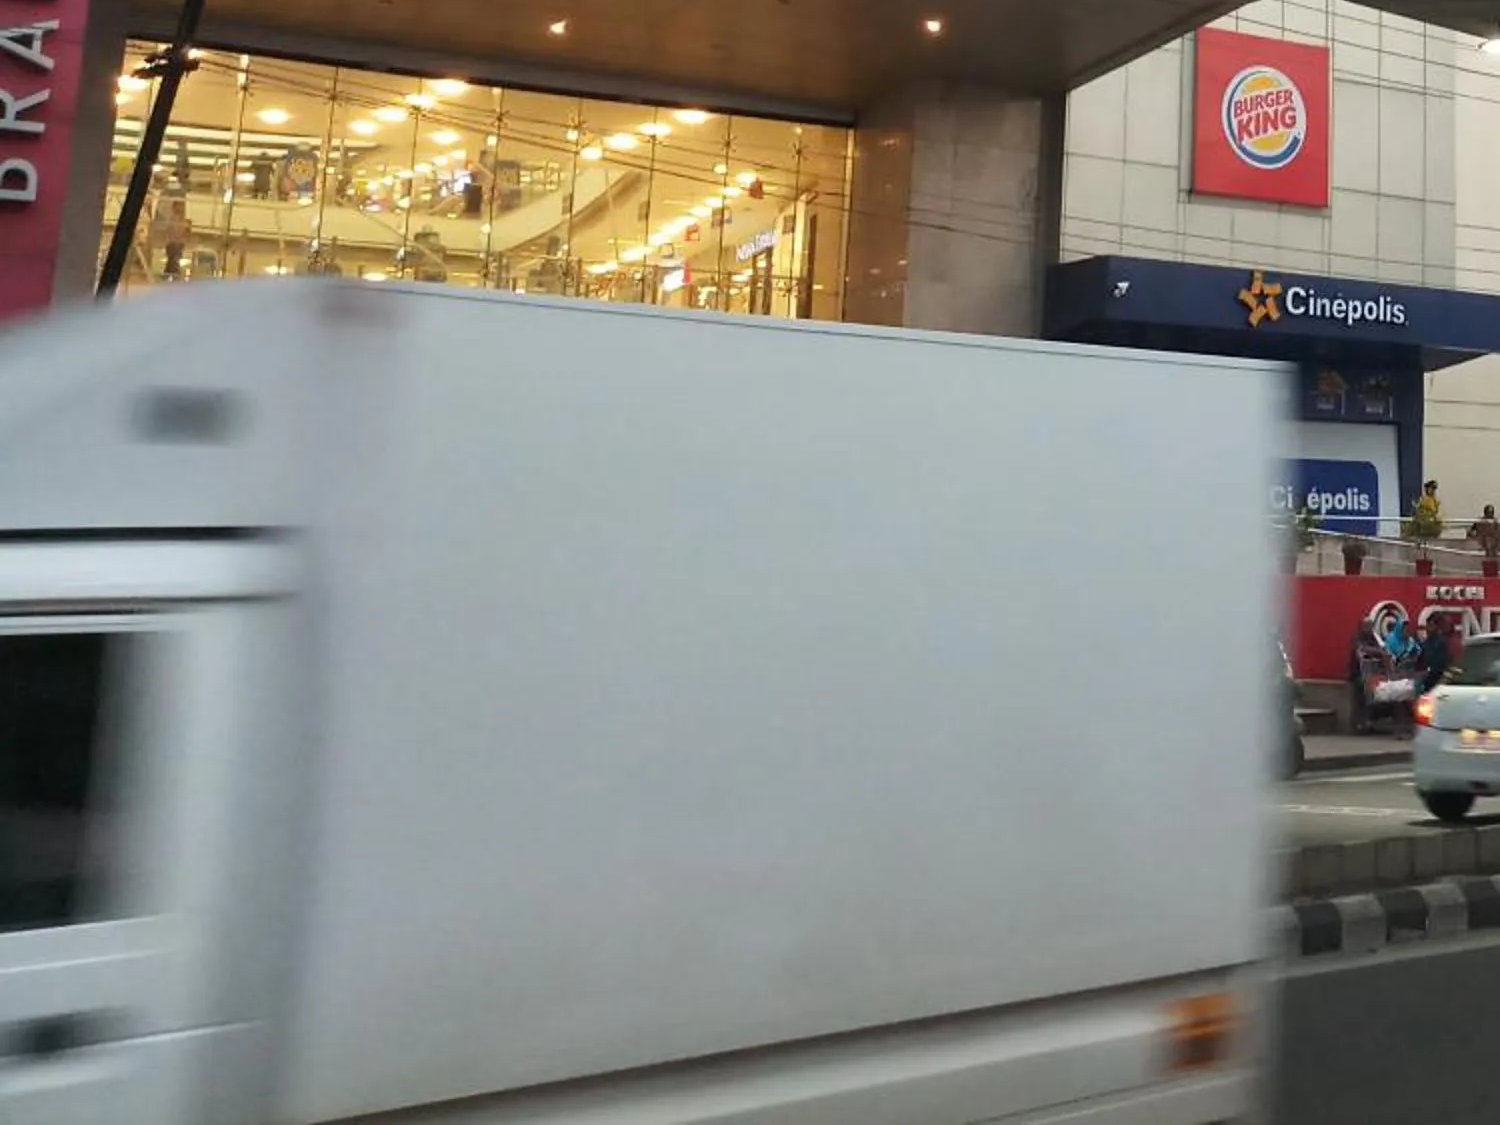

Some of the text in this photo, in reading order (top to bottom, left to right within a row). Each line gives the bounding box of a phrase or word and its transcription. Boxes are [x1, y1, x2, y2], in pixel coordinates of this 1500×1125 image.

[1233, 90, 1293, 119] BURGER
[1237, 106, 1297, 142] KING
[1270, 486, 1370, 516] Ciépolis
